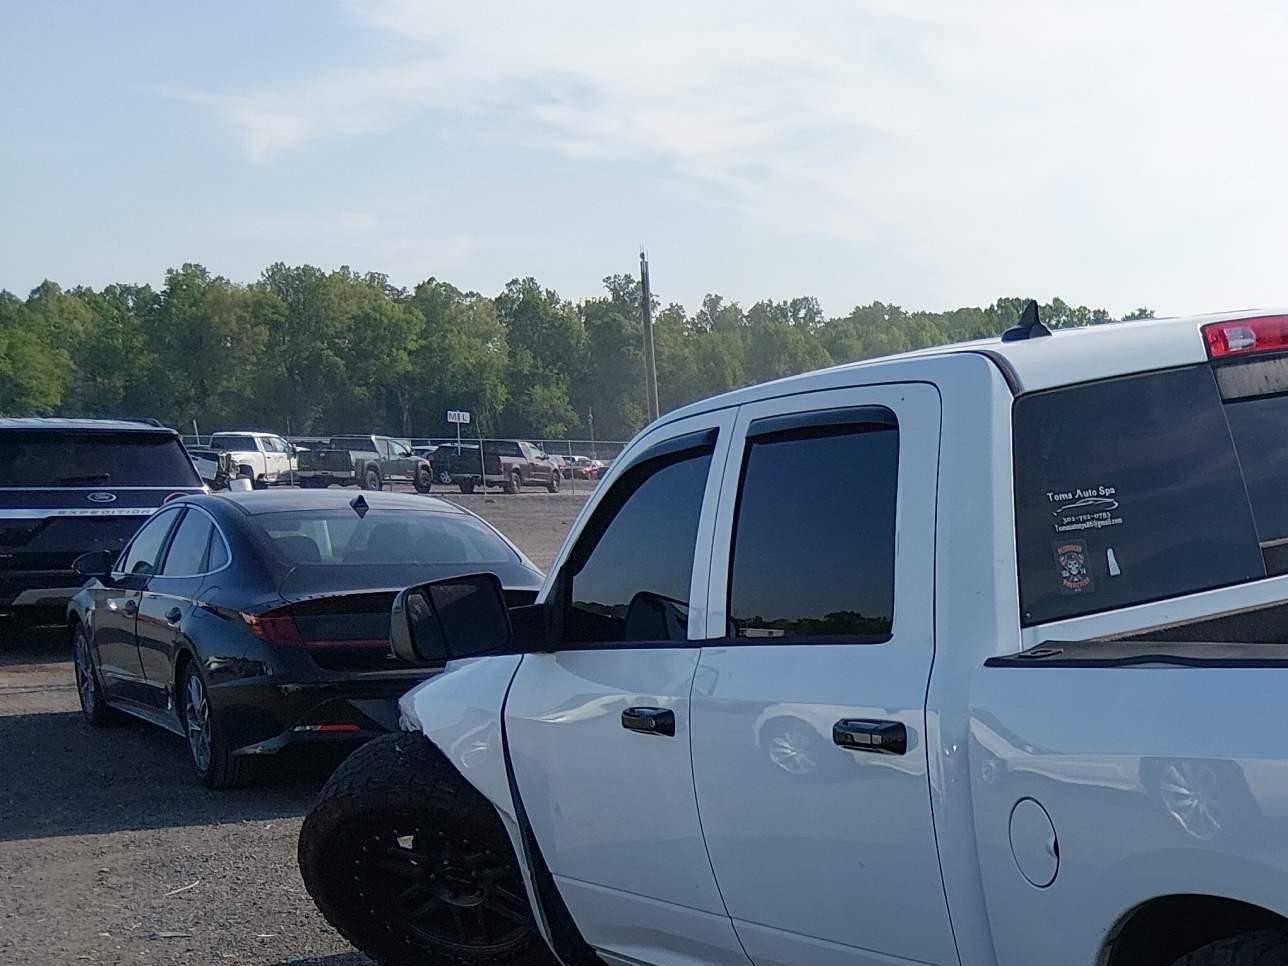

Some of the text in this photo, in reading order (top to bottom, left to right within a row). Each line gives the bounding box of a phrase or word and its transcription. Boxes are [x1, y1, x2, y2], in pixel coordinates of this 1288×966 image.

[1046, 486, 1115, 502] Toms Auto Spa
